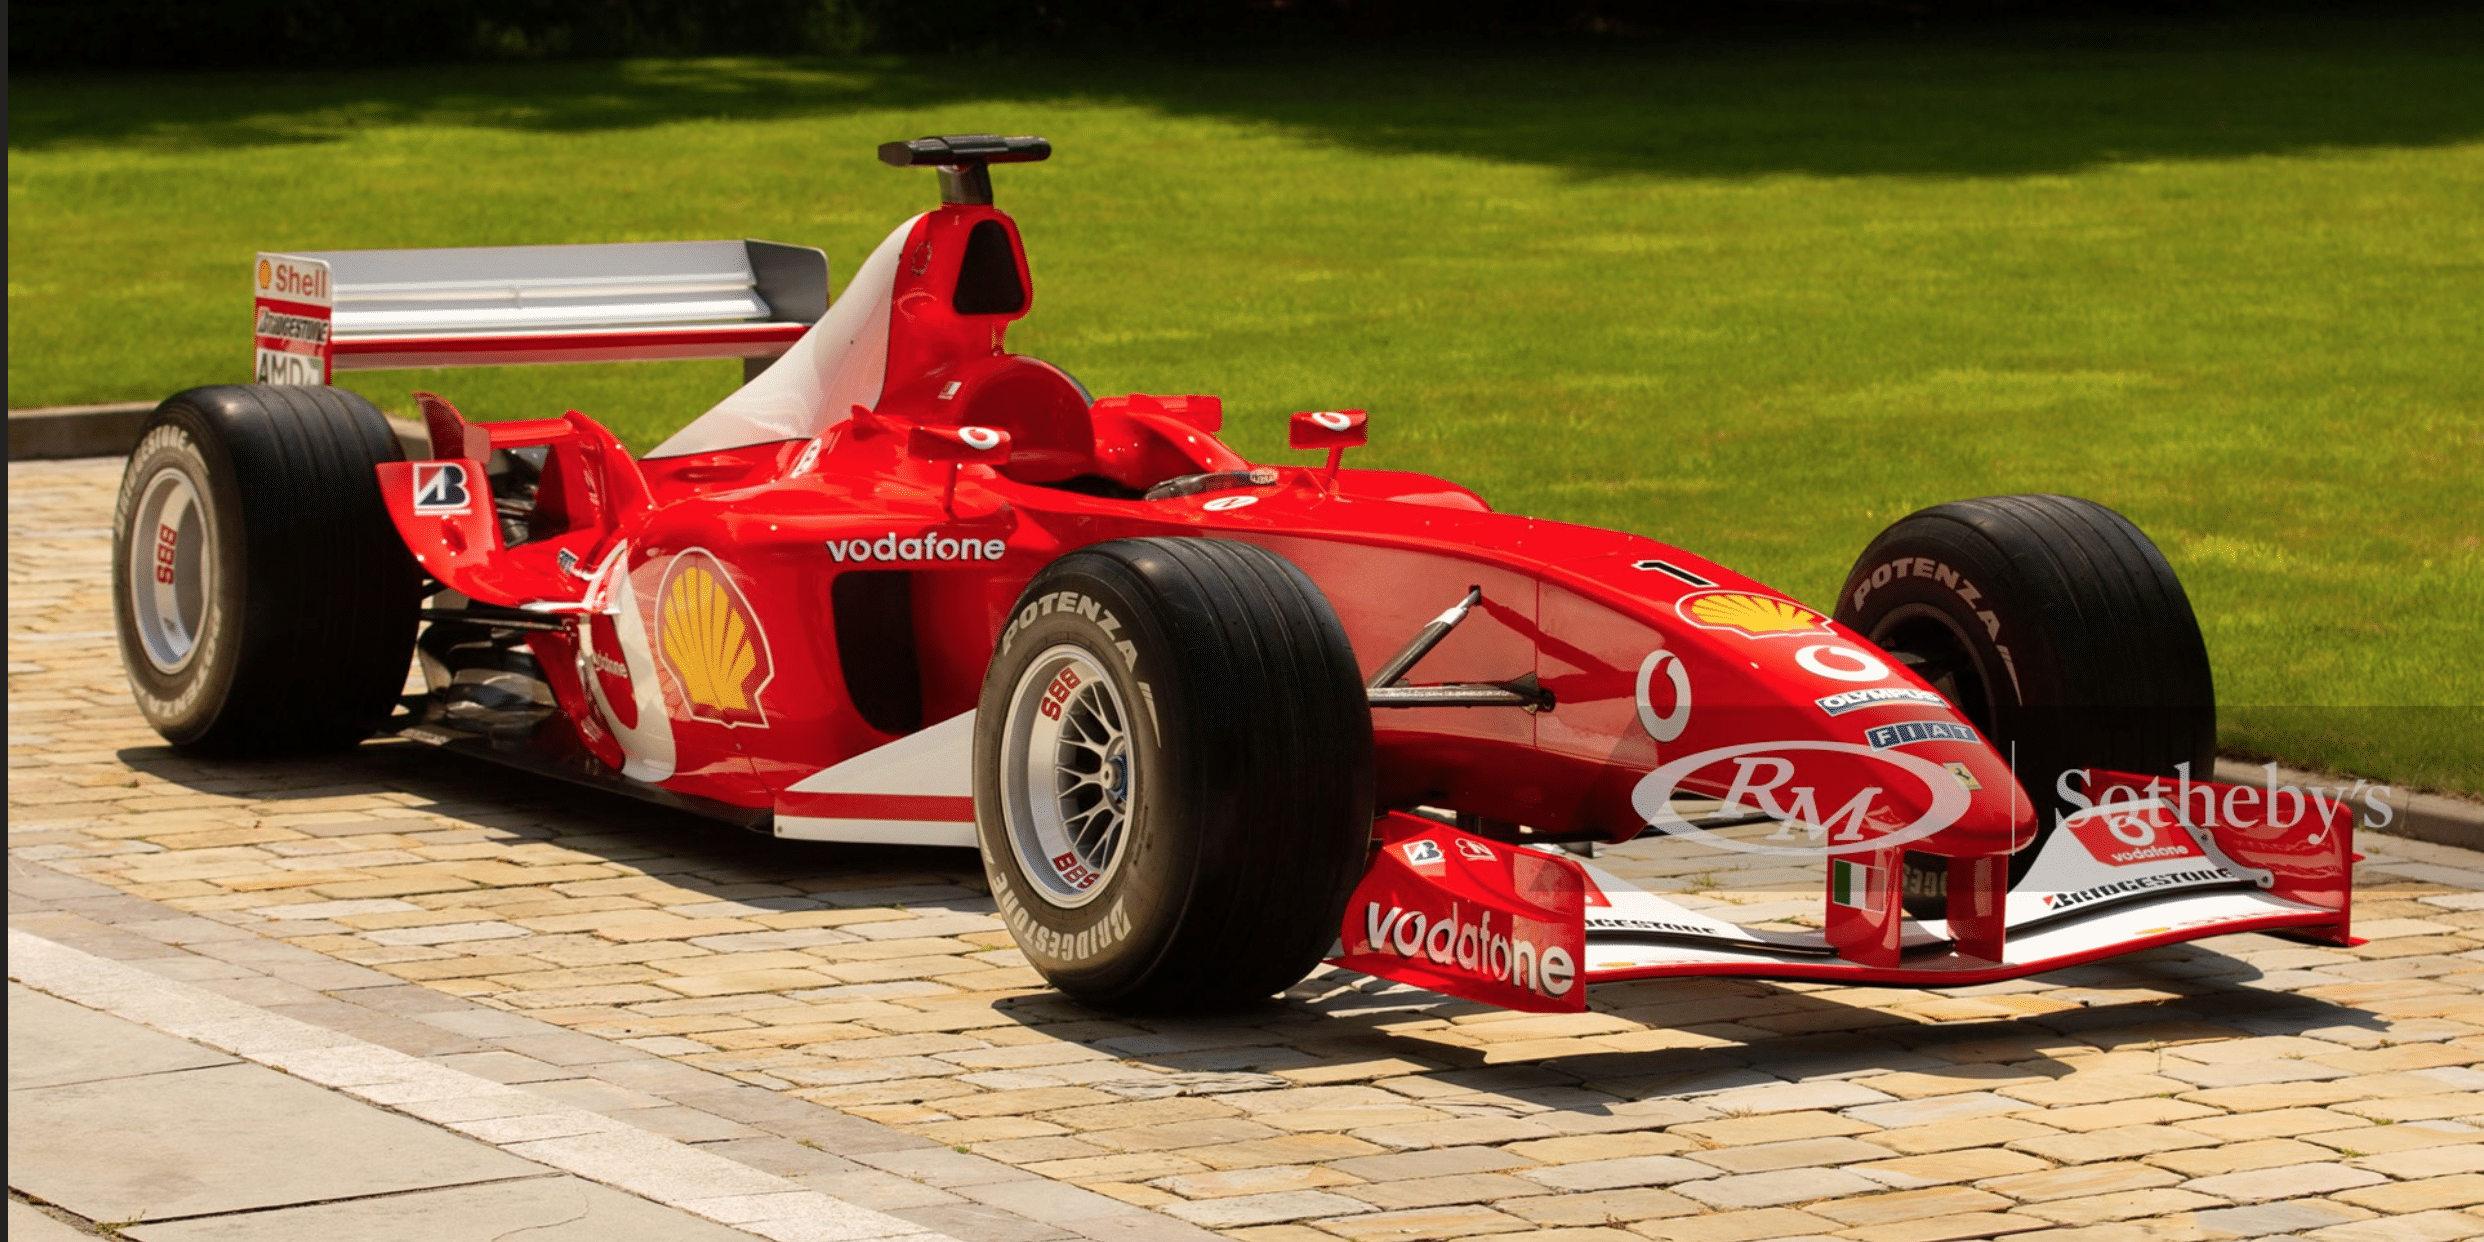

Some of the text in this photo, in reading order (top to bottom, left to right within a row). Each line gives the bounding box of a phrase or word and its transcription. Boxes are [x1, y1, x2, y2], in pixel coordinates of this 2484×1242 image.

[276, 264, 326, 298] Shell
[257, 353, 304, 386] AMD
[156, 524, 177, 584] BBS
[826, 532, 1006, 562] vodafone
[1853, 557, 2000, 643] POTENZA
[1003, 591, 1138, 673] POTENZA
[1041, 667, 1081, 721] BBS
[1823, 688, 1944, 708] OLYMPUS
[1876, 723, 1969, 746] FIAT
[1053, 851, 1101, 890] BBS
[2111, 845, 2190, 862] vodafone
[2051, 867, 2233, 911] BRIDGESTONE
[993, 872, 1132, 962] BRIDGESTONE
[1367, 901, 1577, 996] vodafone
